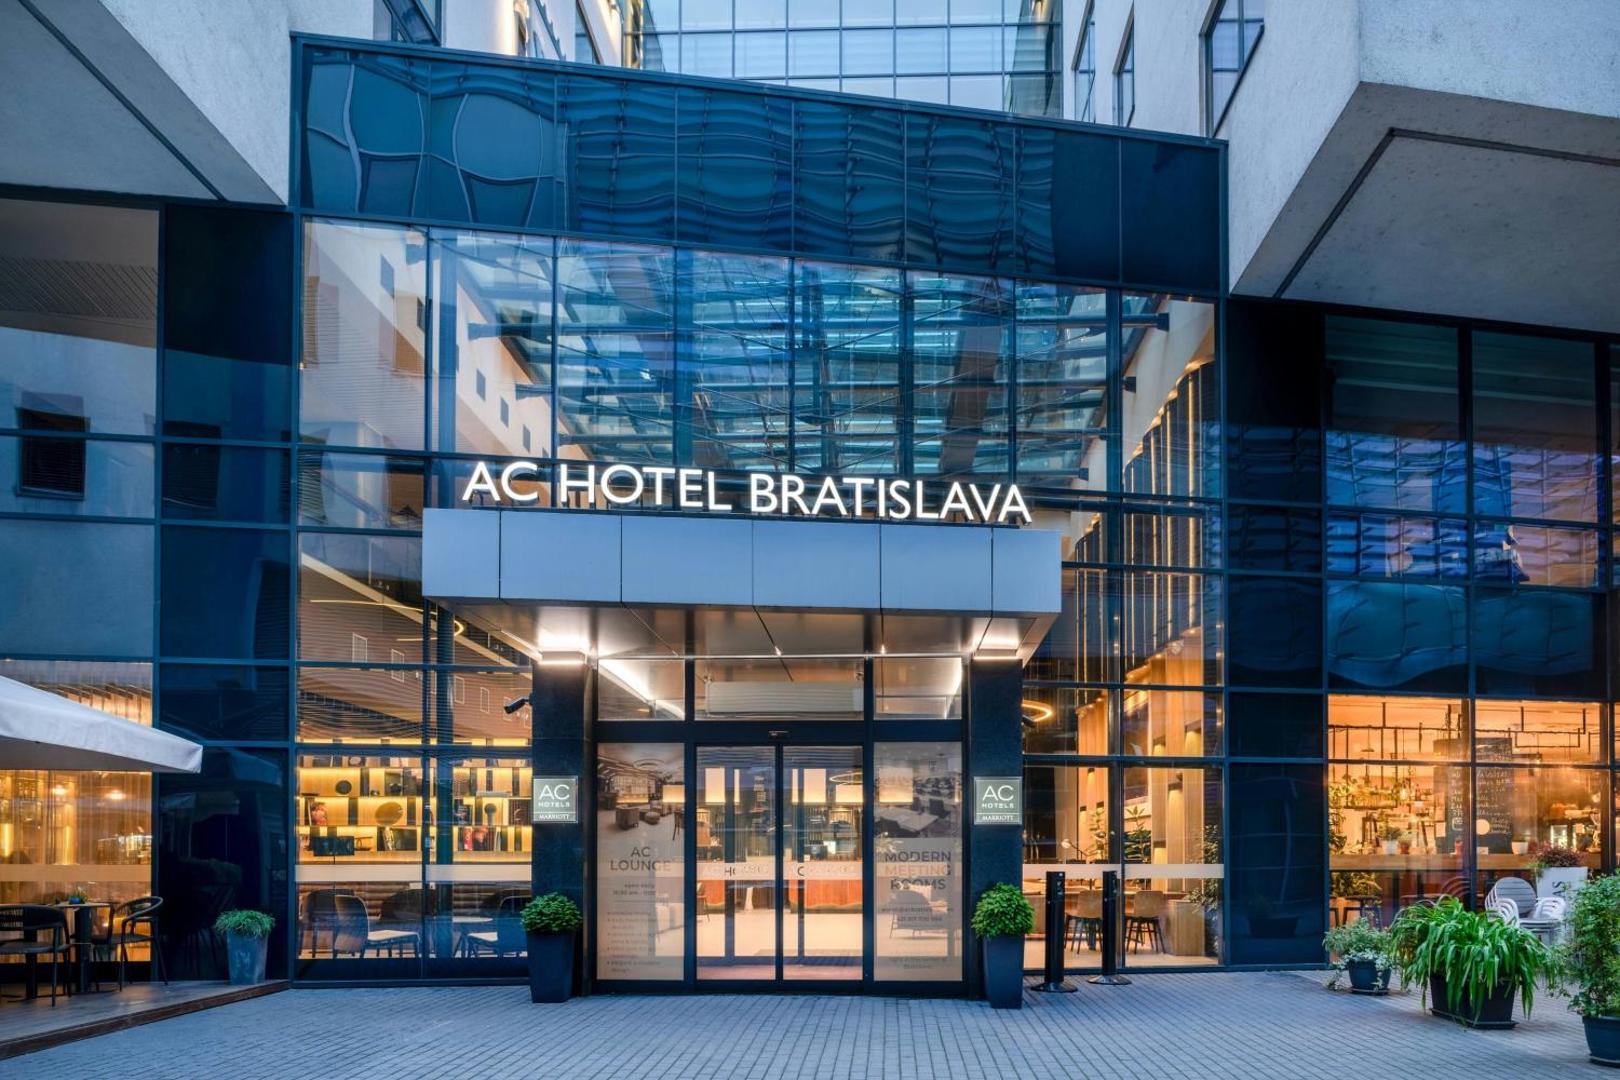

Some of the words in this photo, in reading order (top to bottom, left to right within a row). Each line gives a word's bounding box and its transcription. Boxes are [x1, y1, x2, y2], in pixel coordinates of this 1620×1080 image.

[462, 460, 539, 501] AC
[560, 463, 733, 511] HOTEL
[750, 472, 1033, 523] BRATISLAVA
[539, 784, 570, 800] AC
[982, 785, 1014, 801] AC
[631, 846, 651, 858] AC
[884, 850, 952, 863] MODERN
[610, 859, 672, 872] LOUNGE
[884, 863, 952, 876] MEETING
